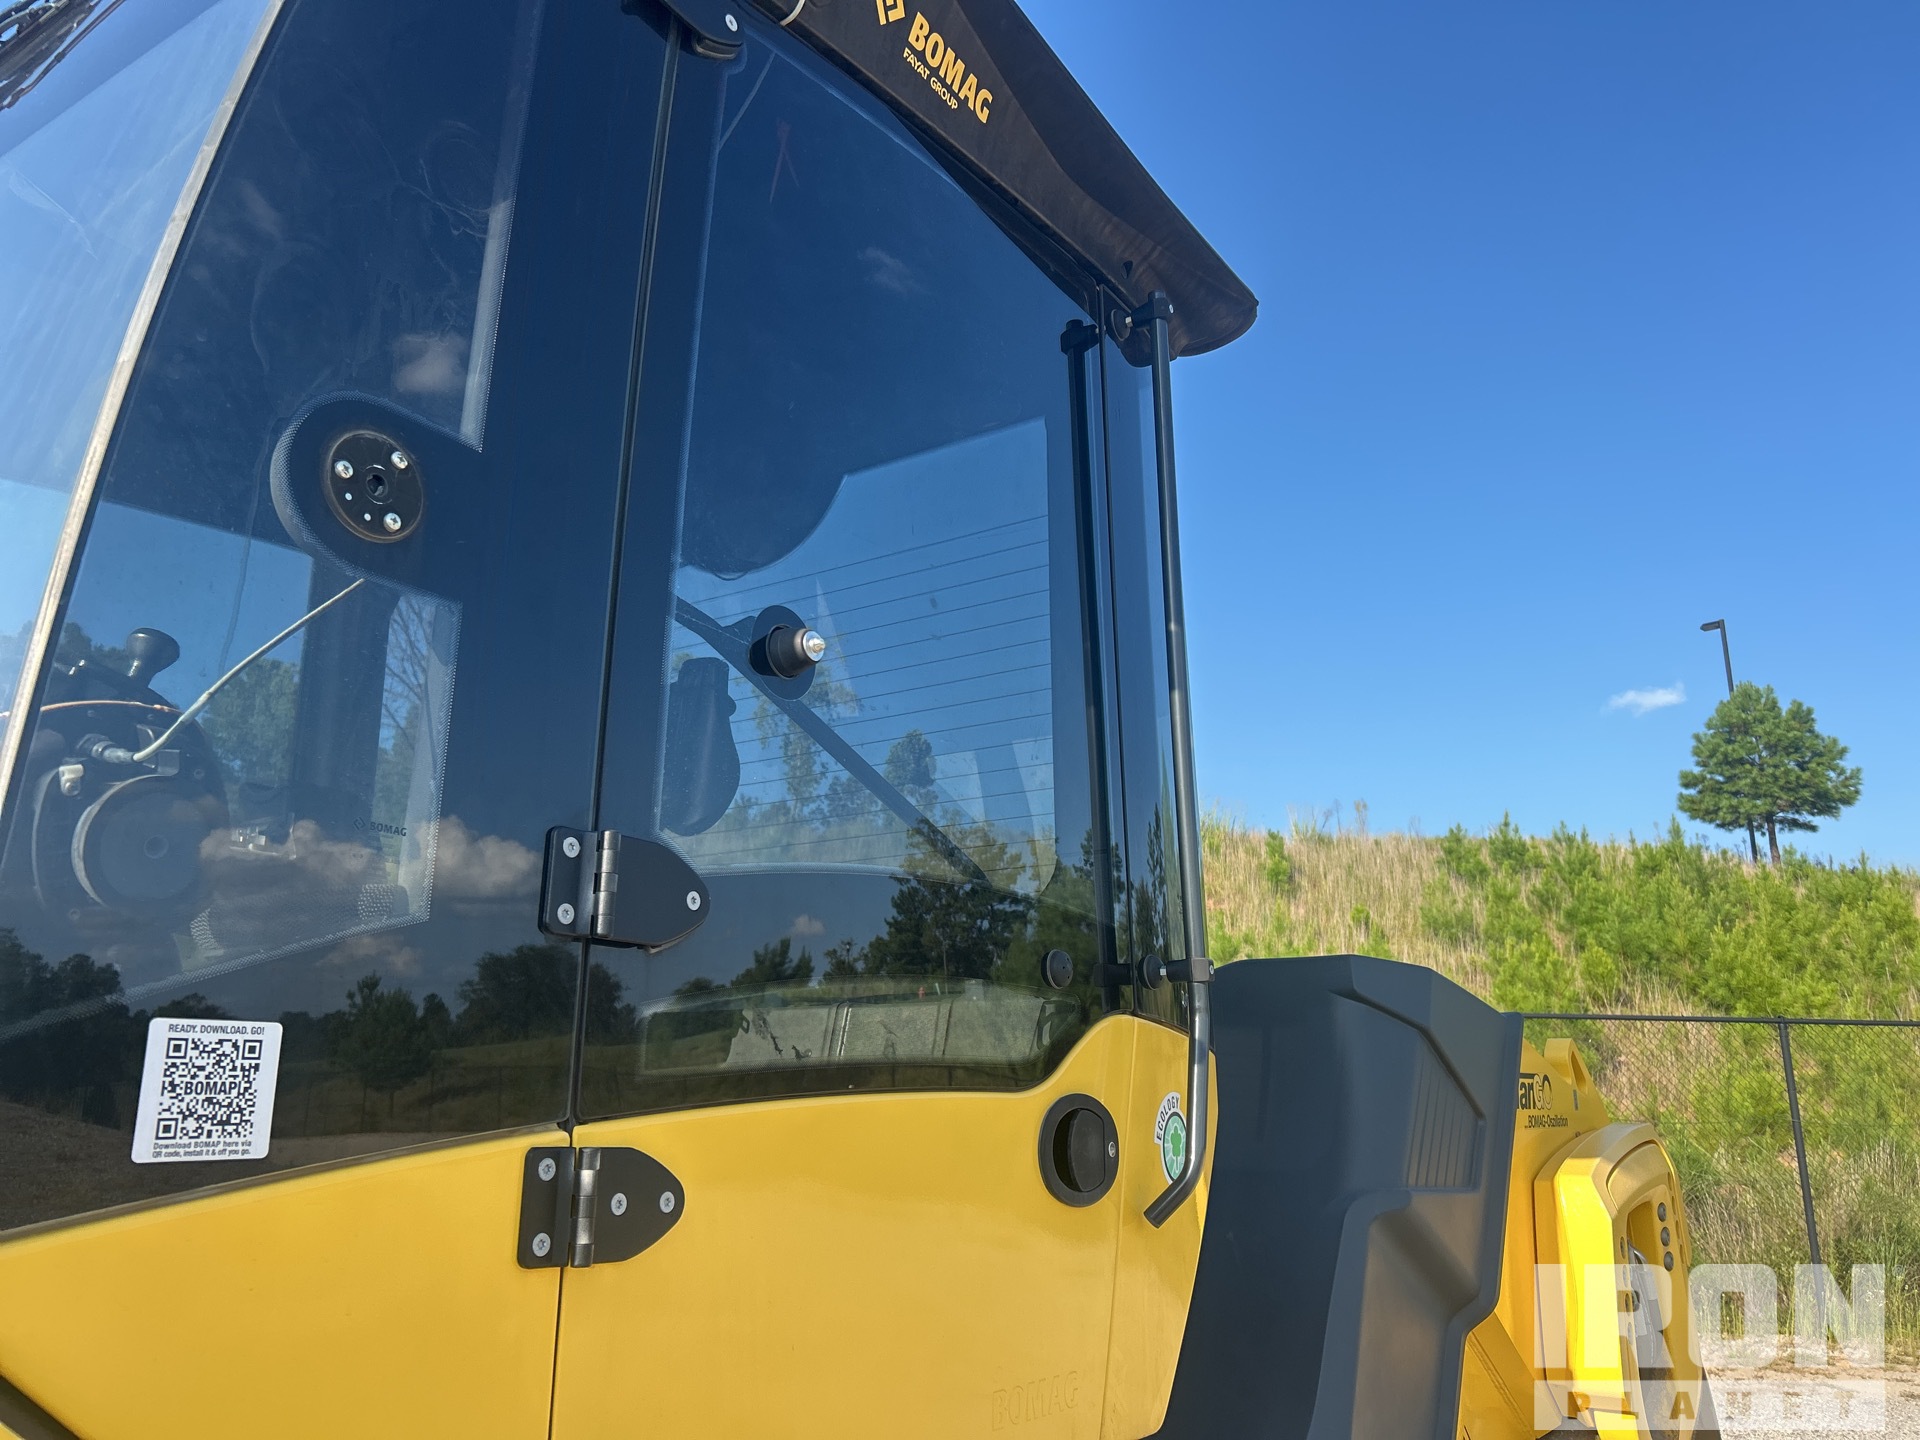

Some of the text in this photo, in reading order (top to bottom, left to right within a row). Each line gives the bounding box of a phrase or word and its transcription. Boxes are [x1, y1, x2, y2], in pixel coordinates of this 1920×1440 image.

[907, 12, 993, 124] BOMAG
[903, 47, 958, 110] FAYAT GROUP
[369, 821, 407, 837] BOMAG
[168, 1023, 265, 1036] READY. DOWNLOAD. GO!
[184, 1081, 238, 1096] BOMAP
[1156, 1096, 1180, 1141] ECOLOGY
[153, 1139, 252, 1151] Download BOMAP here via
[183, 1149, 204, 1157] install
[217, 1148, 227, 1156] off
[227, 1149, 240, 1157] you
[992, 1370, 1079, 1432] BOMAG
